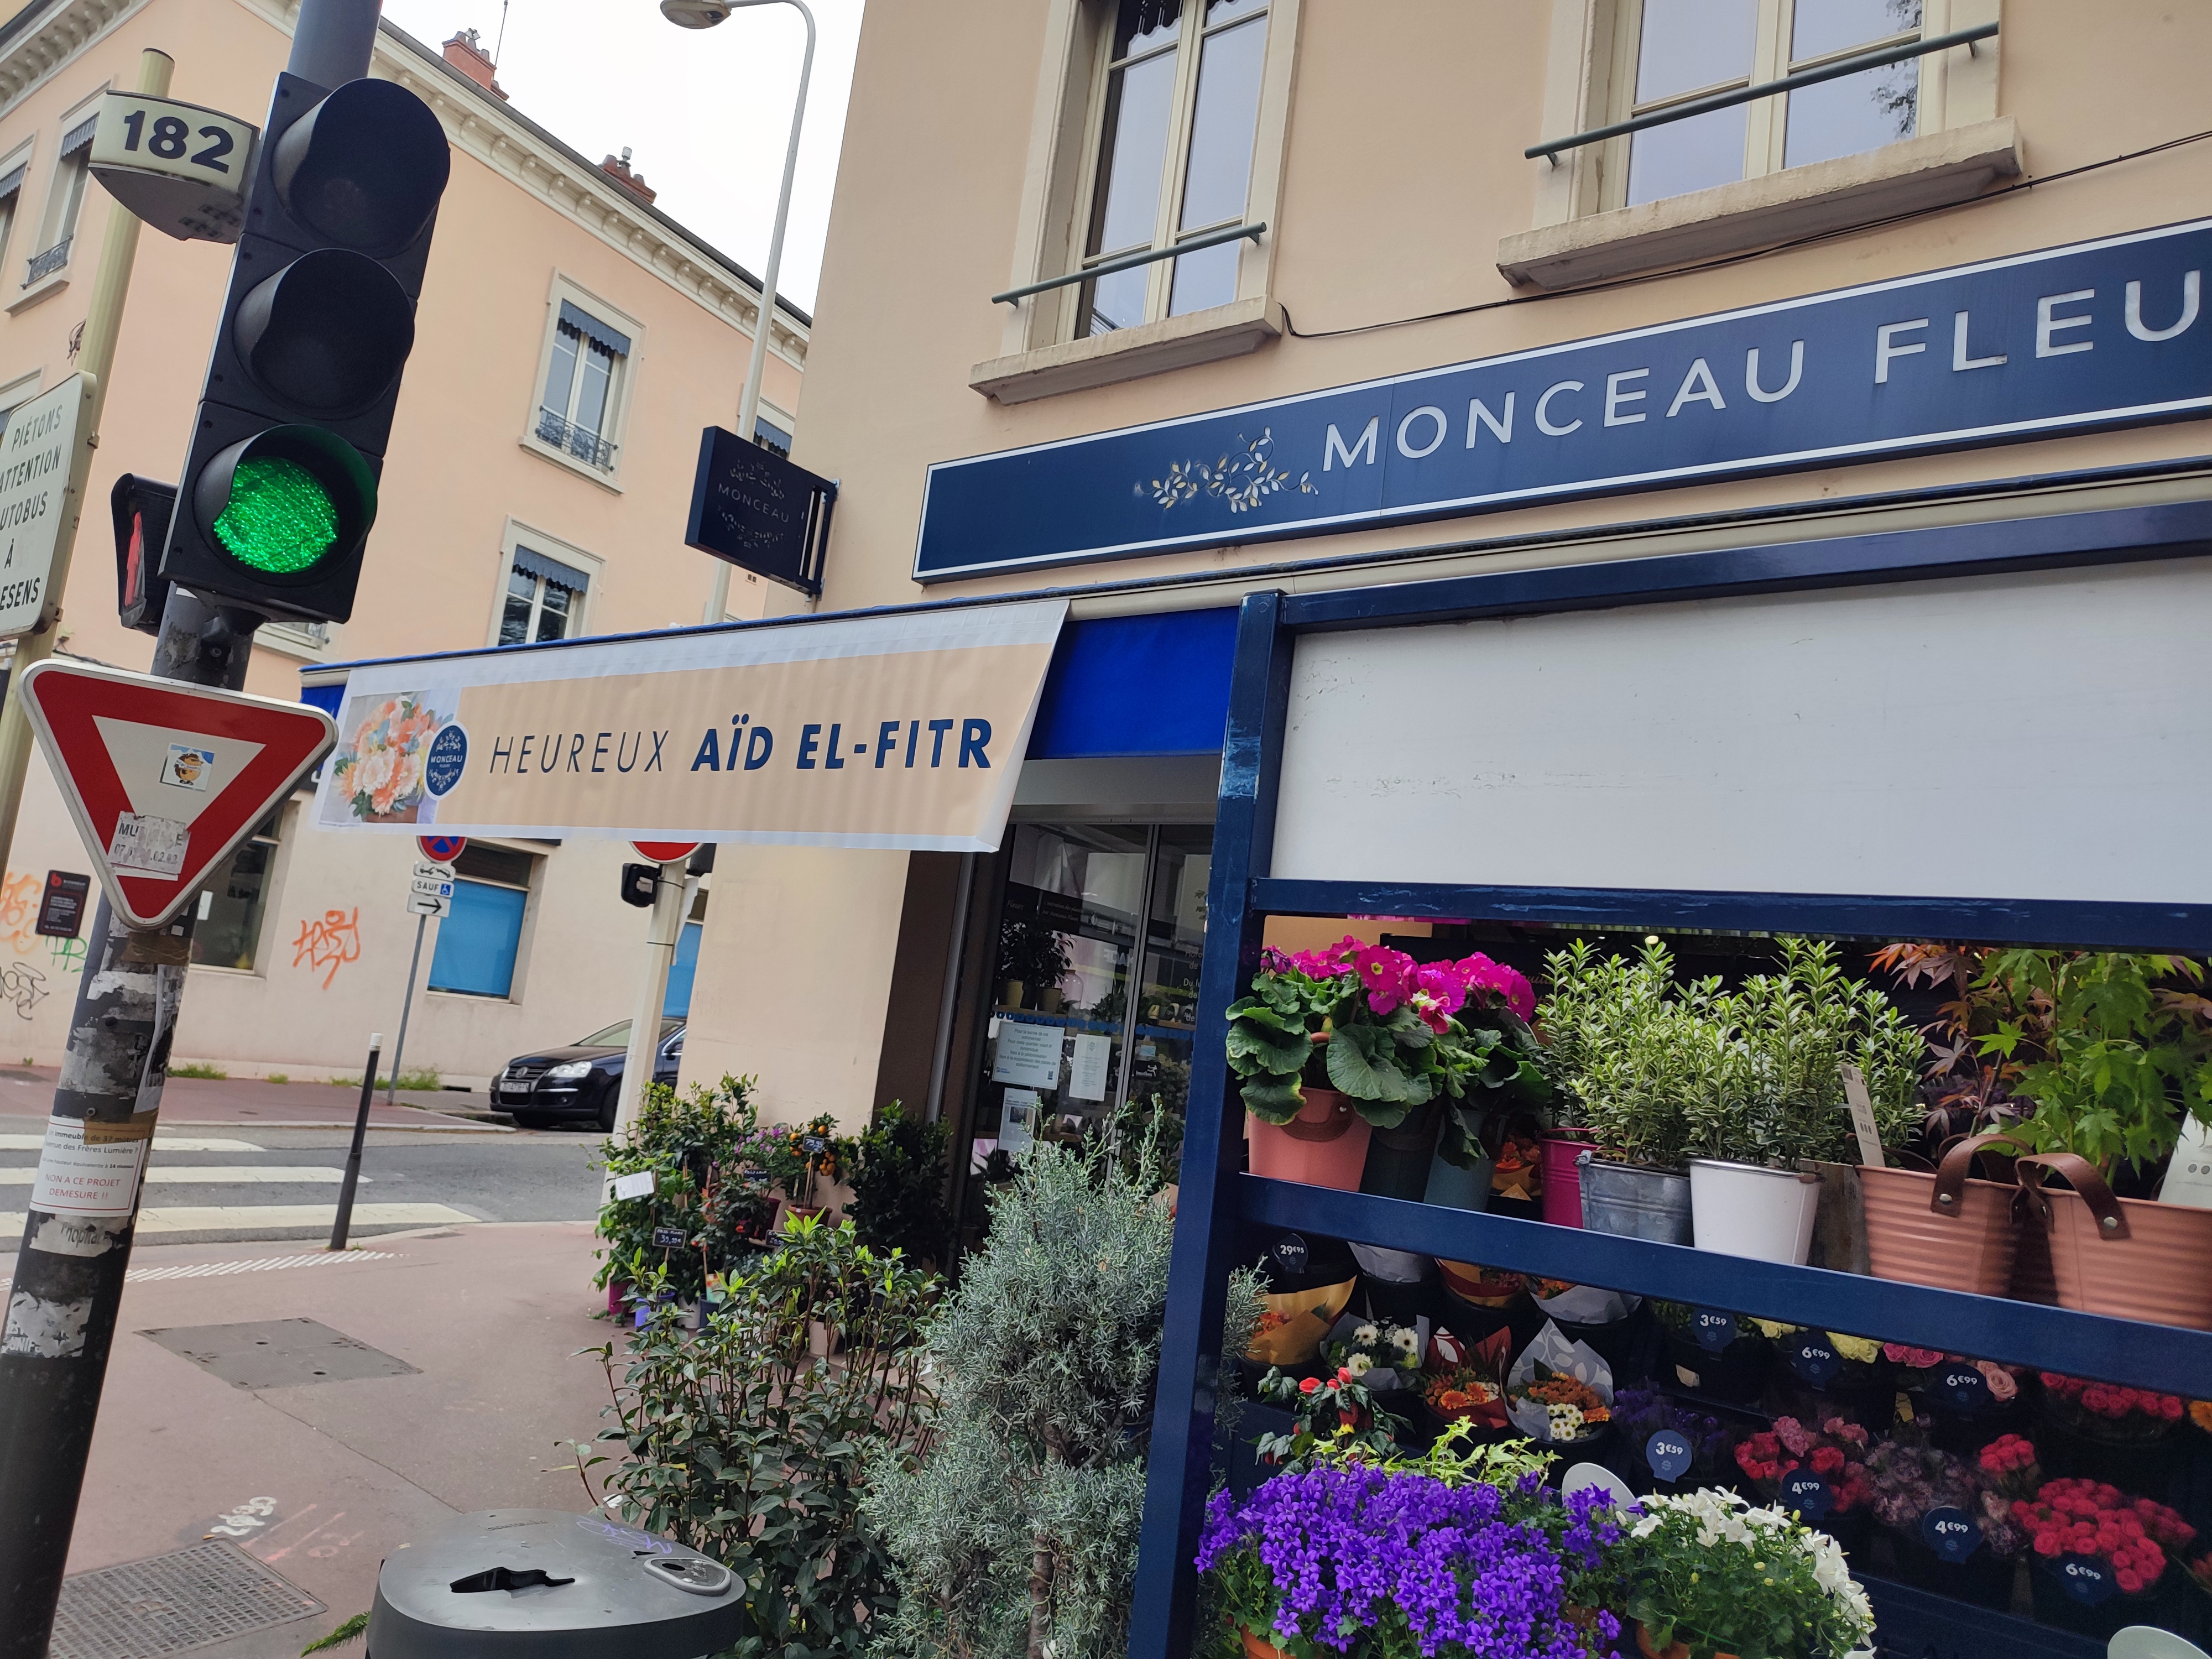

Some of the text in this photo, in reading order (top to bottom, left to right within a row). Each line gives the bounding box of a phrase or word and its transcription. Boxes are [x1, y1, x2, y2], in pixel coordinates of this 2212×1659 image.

[123, 110, 234, 174] 182
[1322, 269, 2201, 471] MONCEAU FLEU
[12, 404, 62, 453] PIÉTONS
[718, 483, 790, 523] MONCEAU
[489, 713, 992, 774] HEUREUX AÏD EL-FITR
[431, 755, 463, 764] MONCEAU
[417, 881, 440, 892] SAUF
[63, 1142, 76, 1151] des
[77, 1144, 102, 1153] Frères
[45, 1173, 121, 1187] NON A CE PROJET
[49, 1187, 98, 1200] DEMESURE
[1280, 1243, 1305, 1255] 29€95
[1700, 1314, 1726, 1327] 3€59
[1801, 1346, 1830, 1360] 6€99
[1946, 1374, 1978, 1387] 6€99
[1655, 1442, 1683, 1455] 3€59
[1792, 1481, 1820, 1495] 4€99
[1935, 1520, 1968, 1534] 4€99
[2065, 1562, 2101, 1581] 6€99
